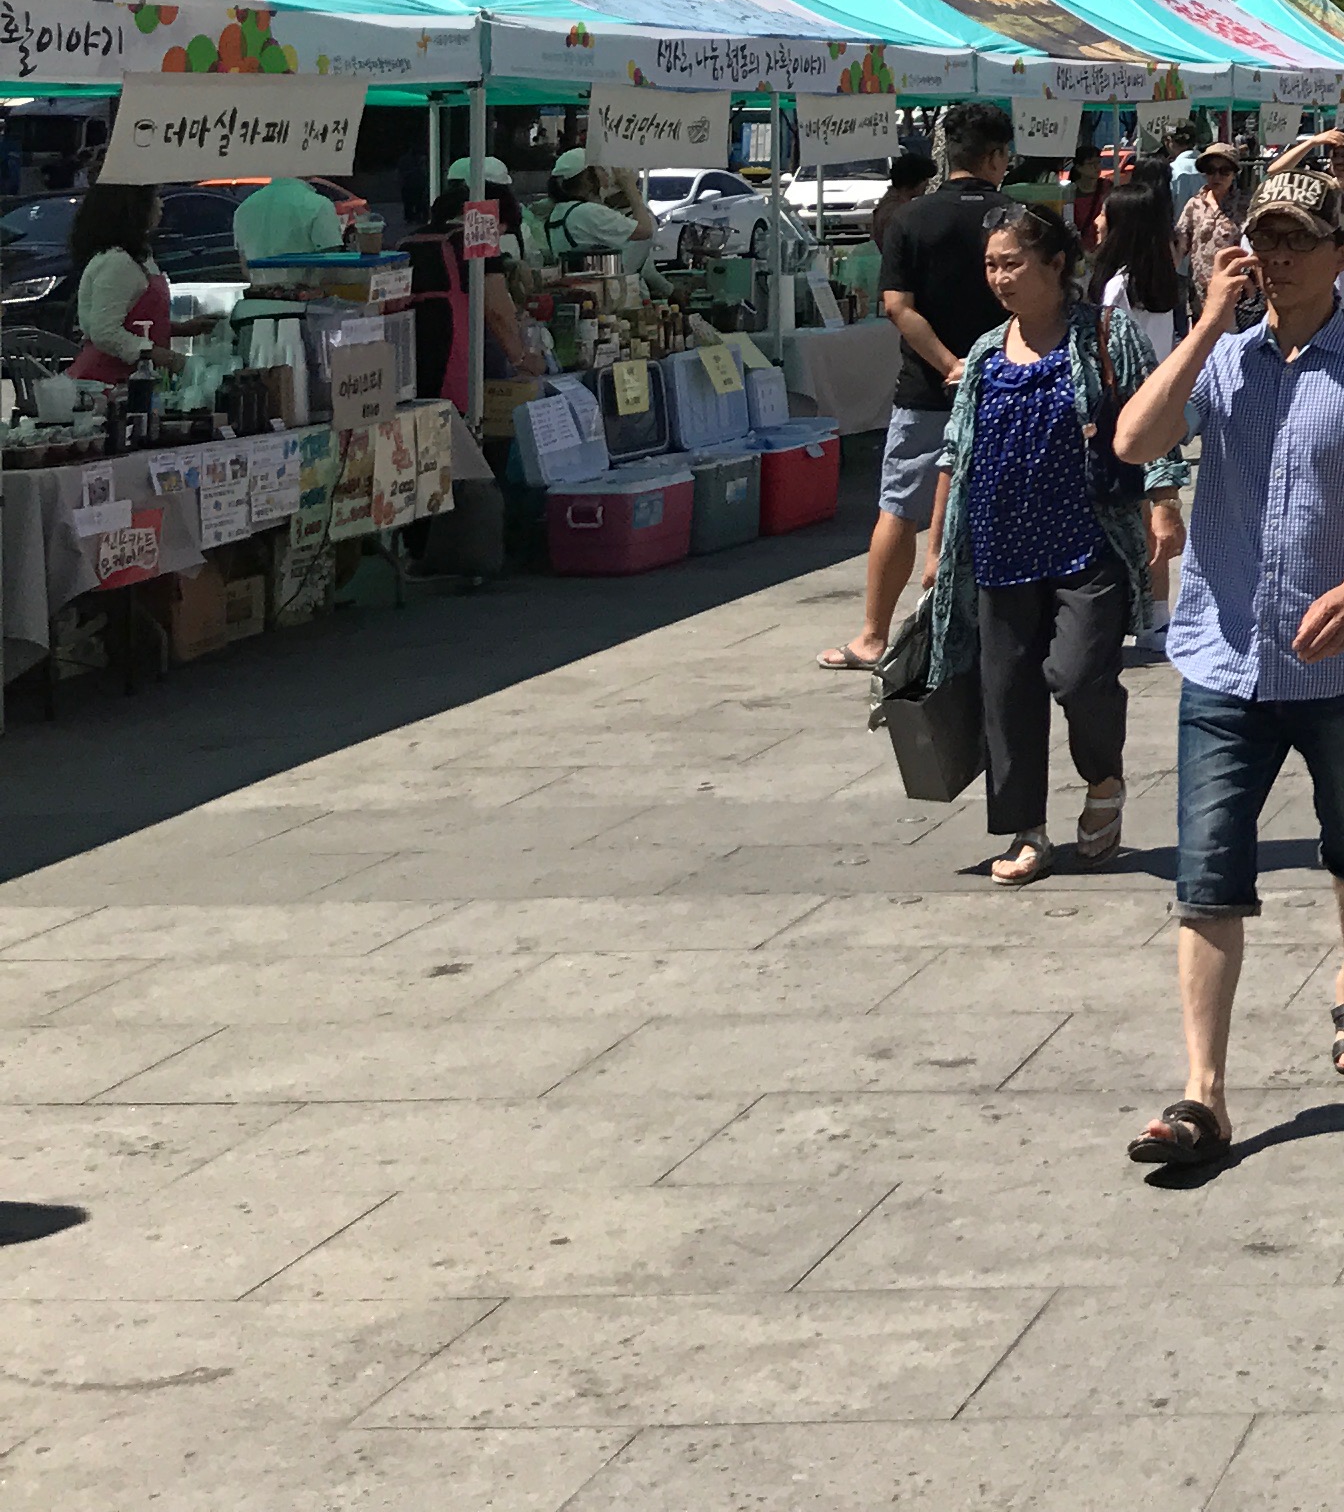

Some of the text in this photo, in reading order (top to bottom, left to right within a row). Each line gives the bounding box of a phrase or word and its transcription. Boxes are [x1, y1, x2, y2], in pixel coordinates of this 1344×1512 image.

[0, 0, 123, 78] 활이야기
[163, 106, 290, 157] 더마실카페
[1257, 186, 1319, 206] STARS
